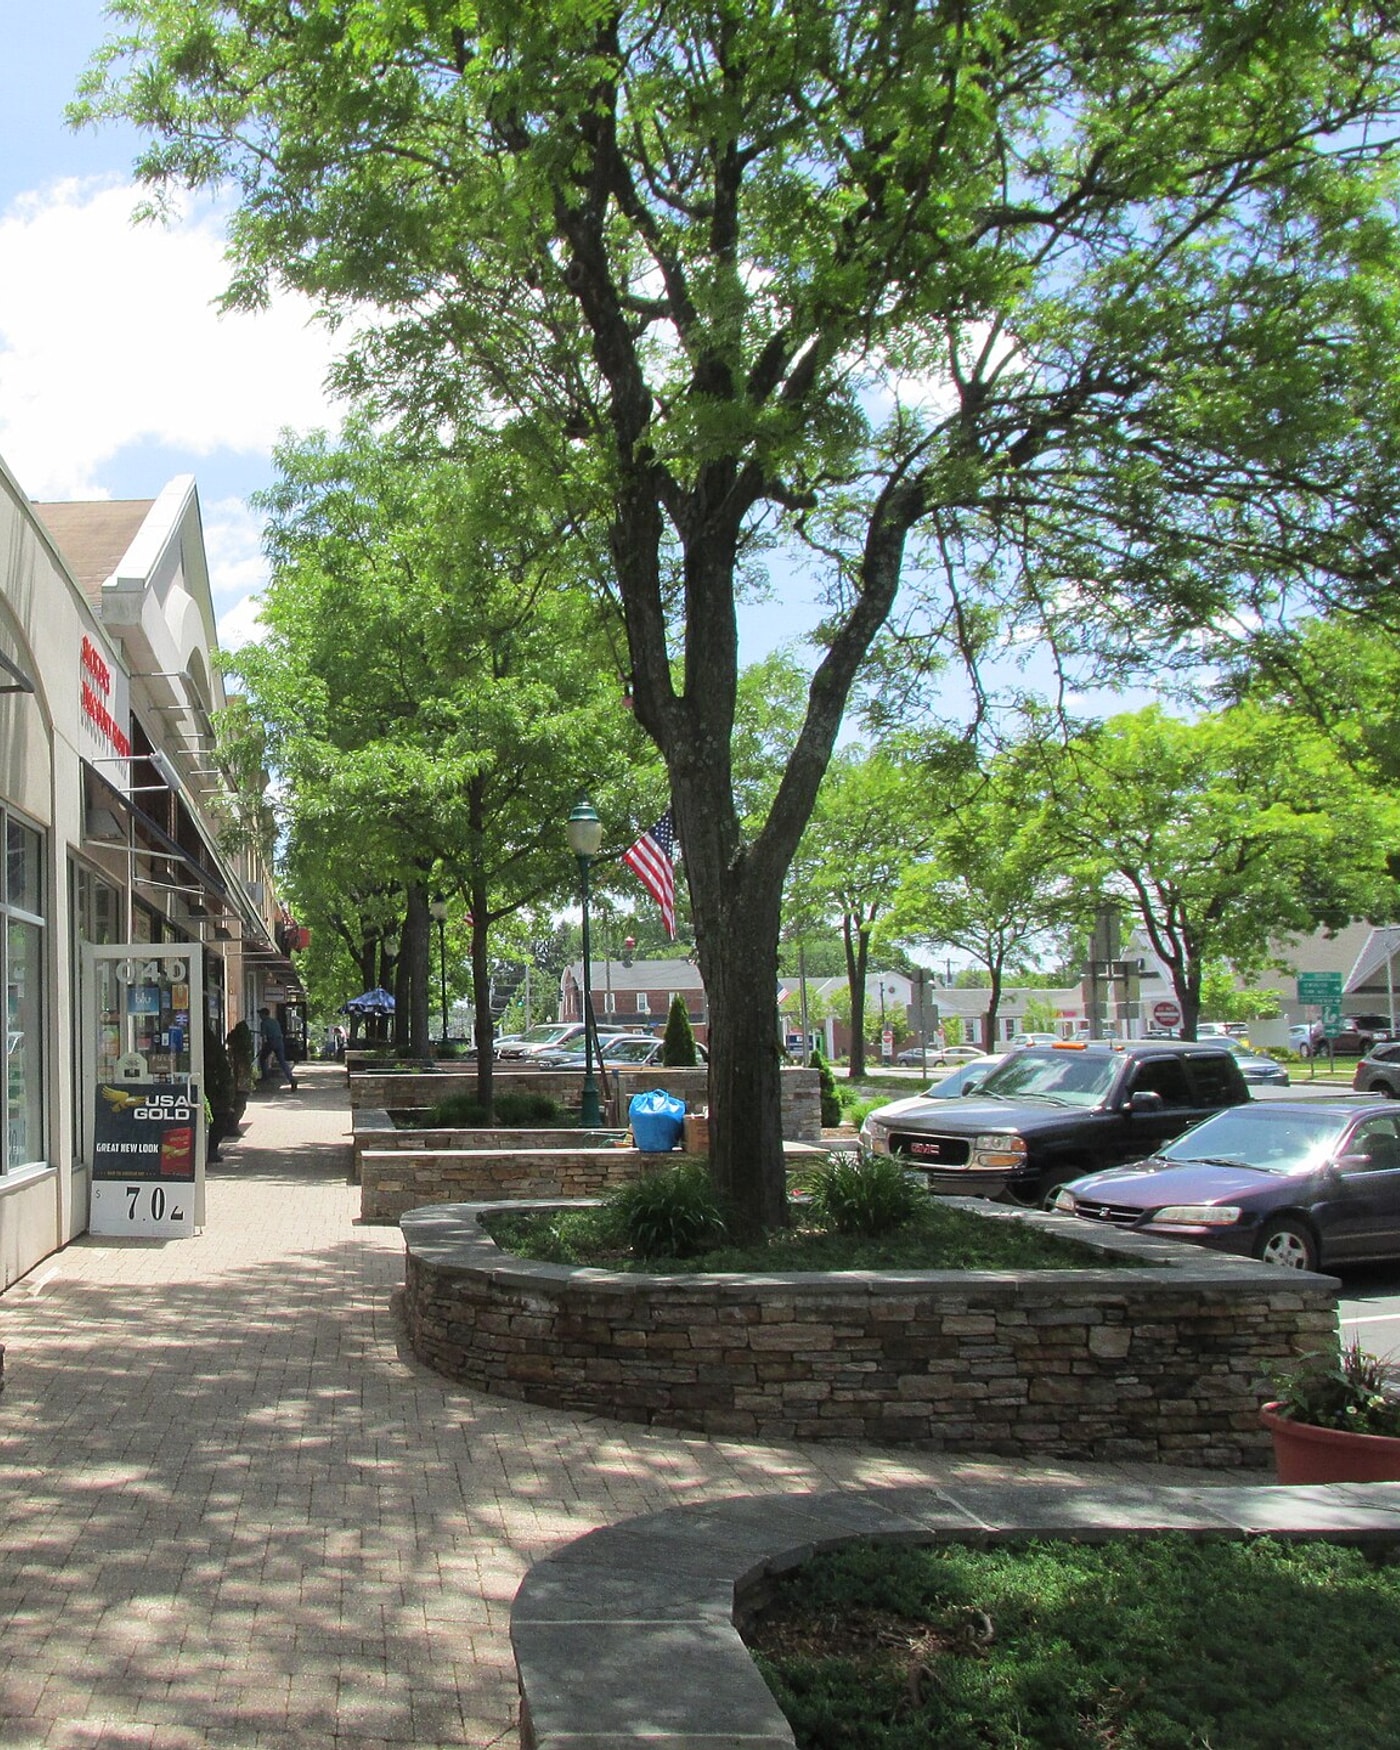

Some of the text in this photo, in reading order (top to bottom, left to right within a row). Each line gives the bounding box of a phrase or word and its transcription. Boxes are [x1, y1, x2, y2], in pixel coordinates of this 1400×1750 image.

[97, 960, 186, 982] 1040
[145, 1095, 189, 1107] USA
[134, 1108, 190, 1120] GOLD
[96, 1143, 159, 1153] GREAT NEW LOOK
